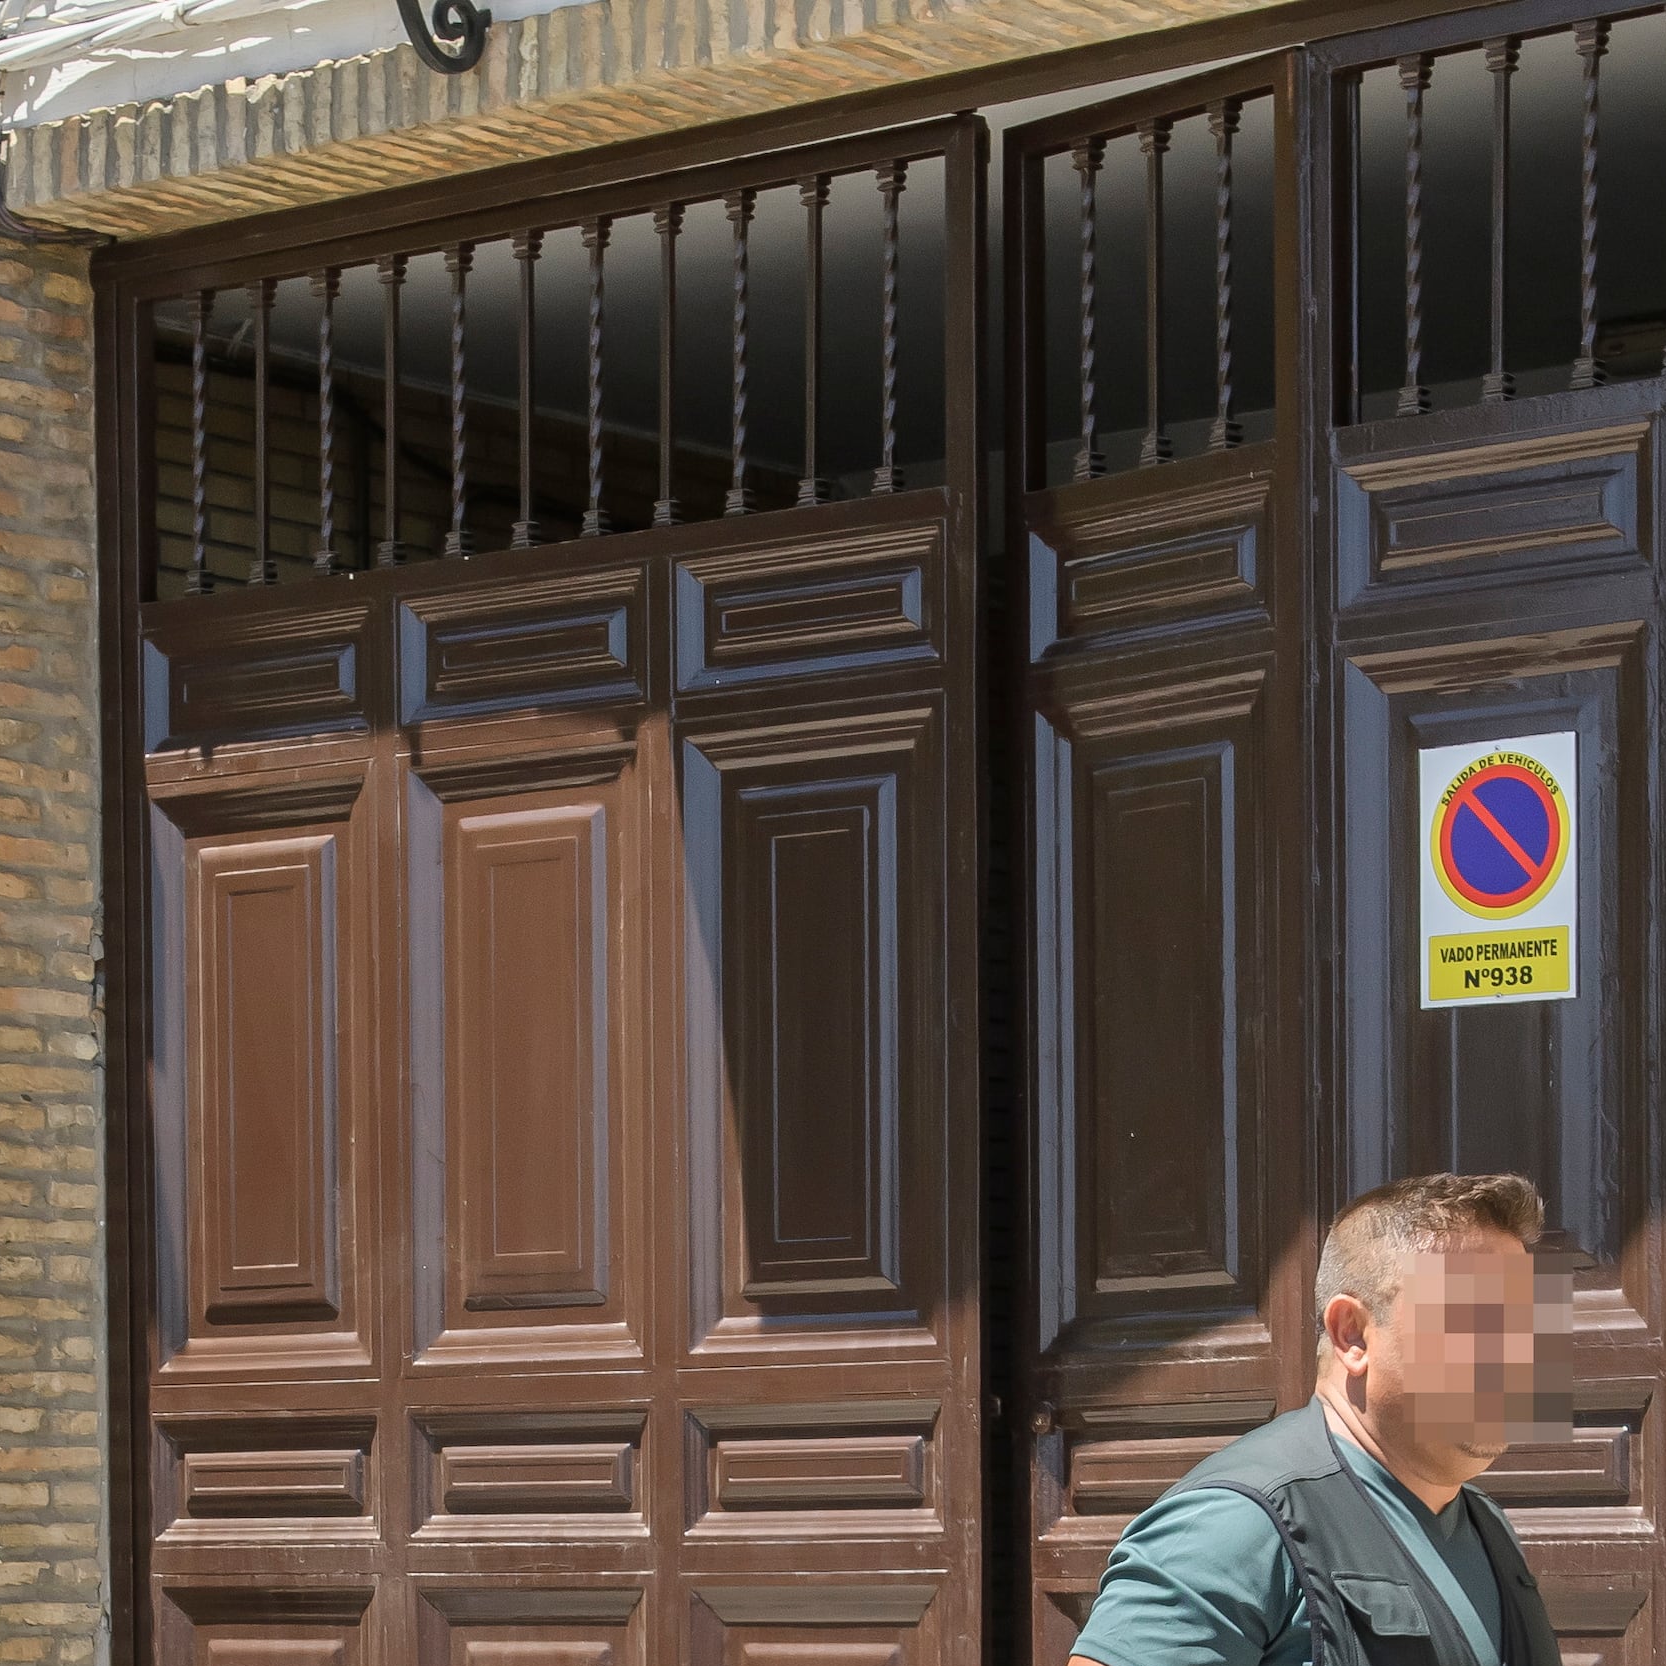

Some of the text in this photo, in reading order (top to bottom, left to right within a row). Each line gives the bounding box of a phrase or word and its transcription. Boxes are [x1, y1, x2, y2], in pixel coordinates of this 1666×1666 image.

[1442, 766, 1476, 806] SALIDA
[1478, 755, 1494, 769] DE
[1440, 938, 1558, 963] VADO PERMANENTE
[1464, 965, 1533, 989] Nº938
